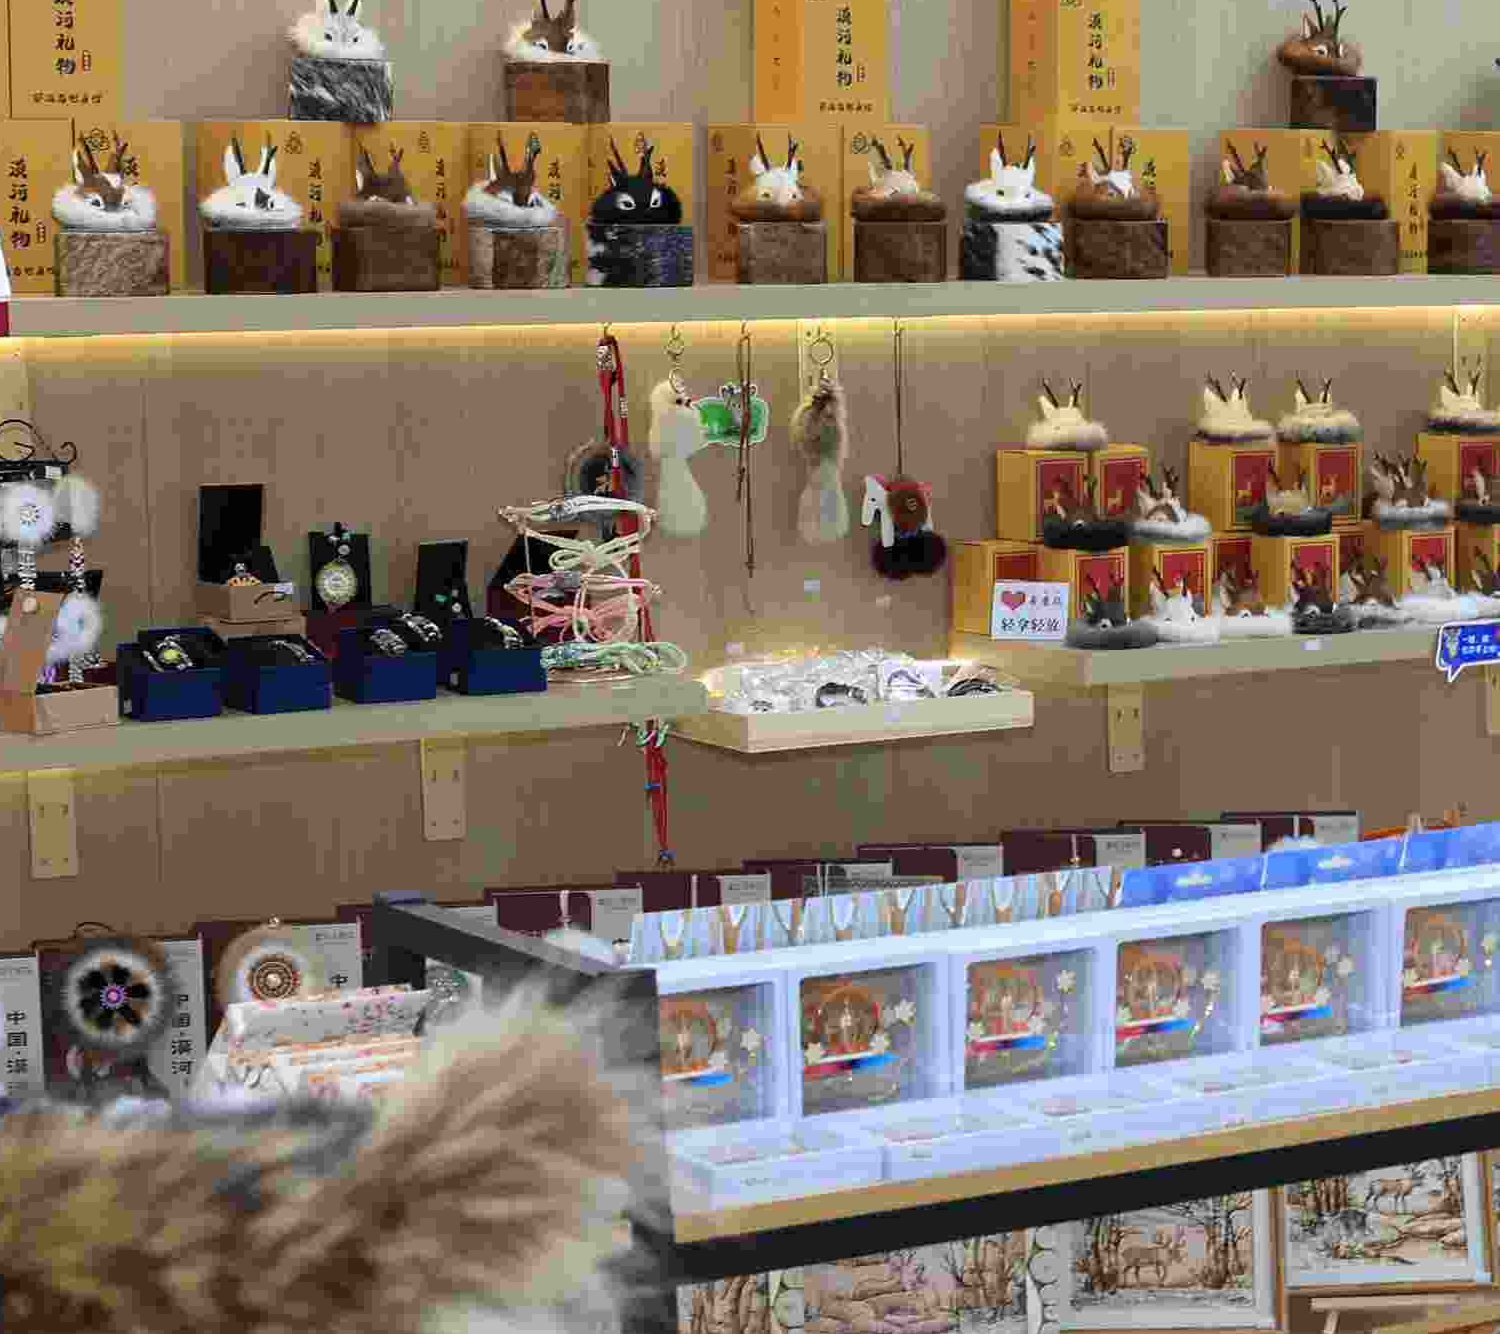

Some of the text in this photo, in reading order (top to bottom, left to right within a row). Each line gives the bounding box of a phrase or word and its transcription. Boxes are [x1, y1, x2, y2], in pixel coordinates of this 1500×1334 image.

[835, 6, 853, 89] 漠河礼物
[1086, 11, 1103, 90] 漠河礼物
[8, 157, 31, 250] 漠河礼物
